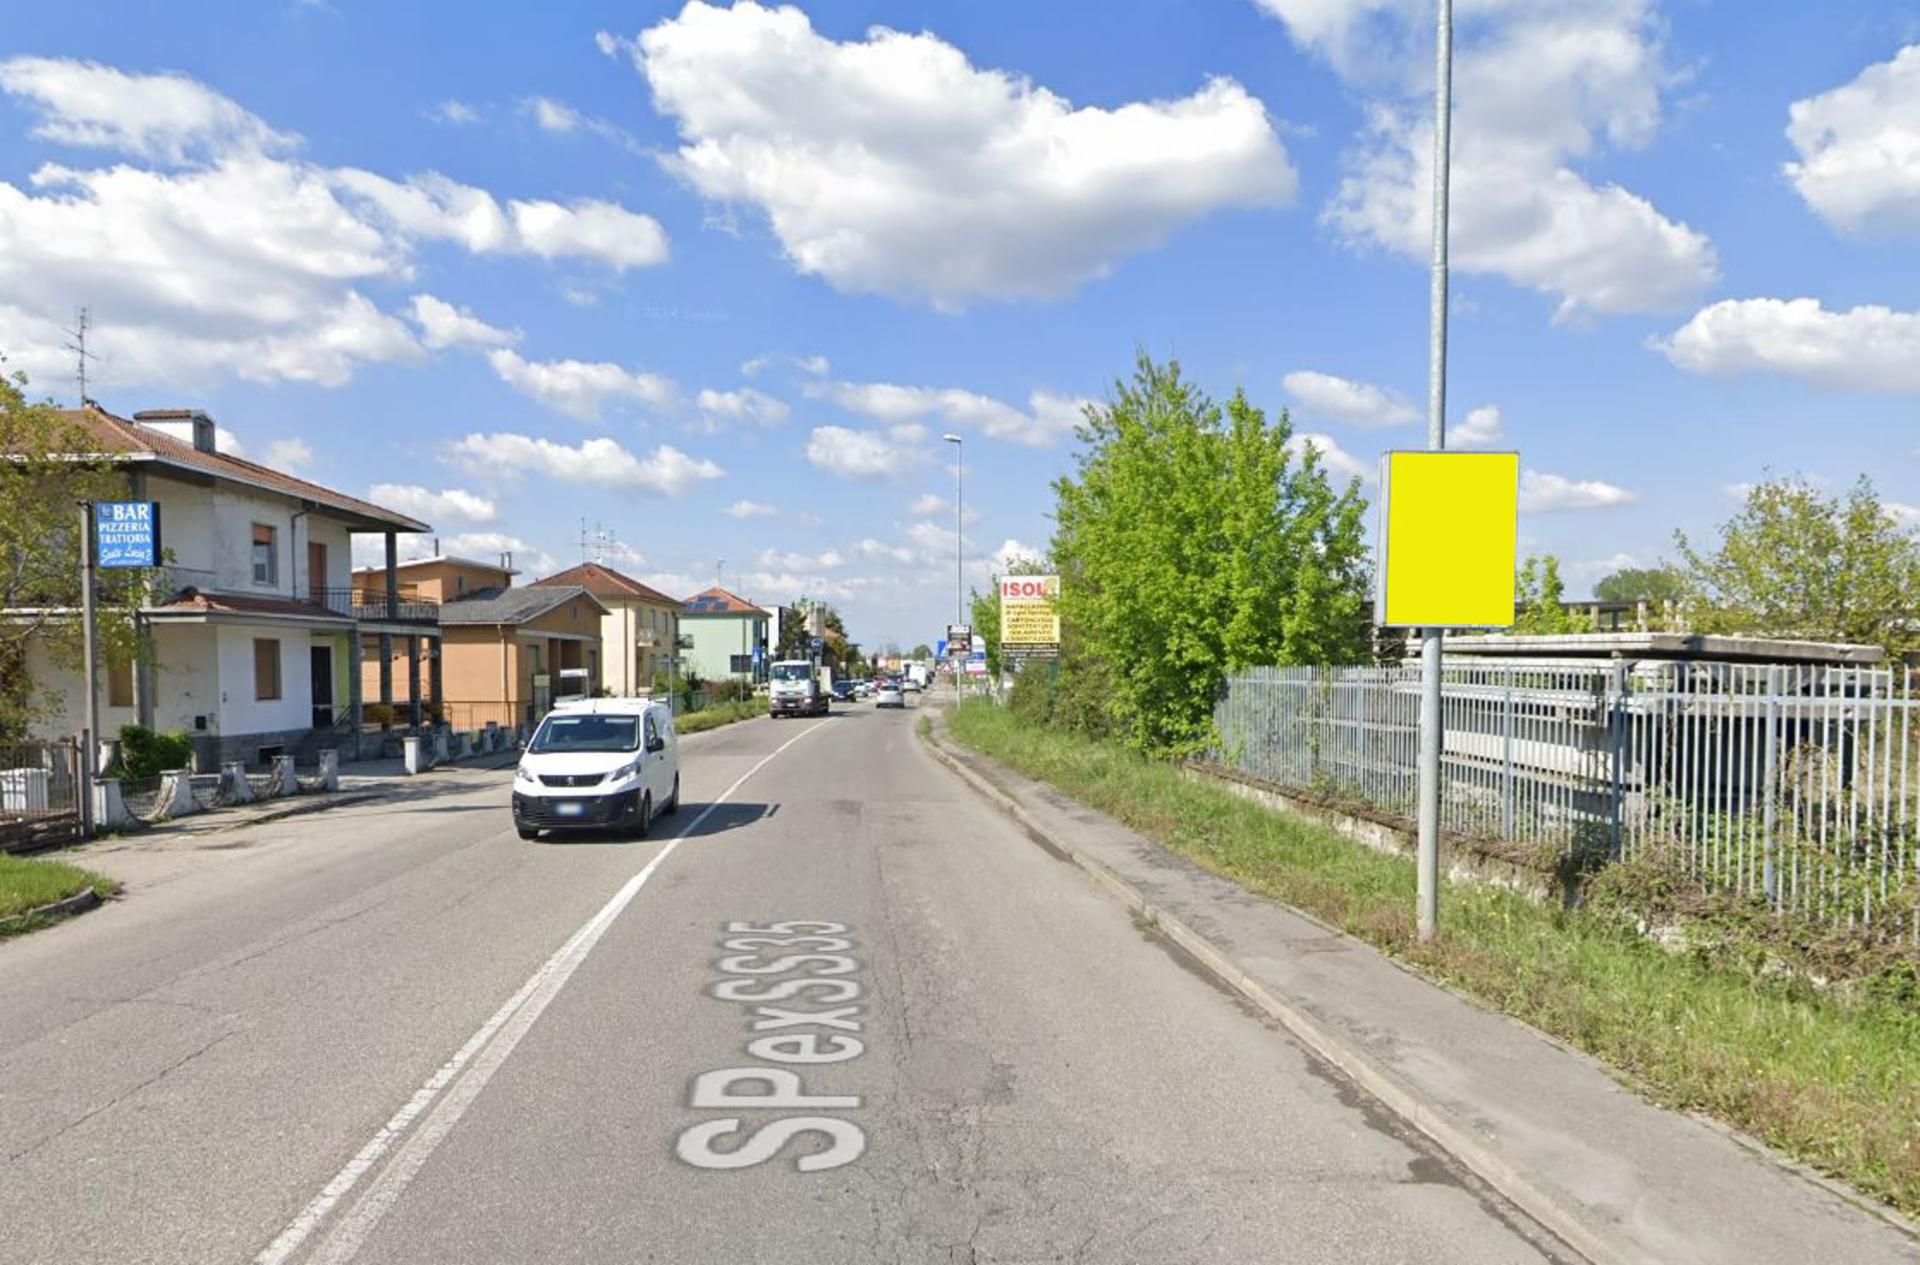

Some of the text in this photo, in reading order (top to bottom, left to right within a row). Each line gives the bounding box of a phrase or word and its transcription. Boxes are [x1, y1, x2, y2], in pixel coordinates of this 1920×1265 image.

[113, 503, 149, 520] BAR
[98, 522, 151, 532] PIZZERIA
[99, 533, 151, 544] TRATTORIA
